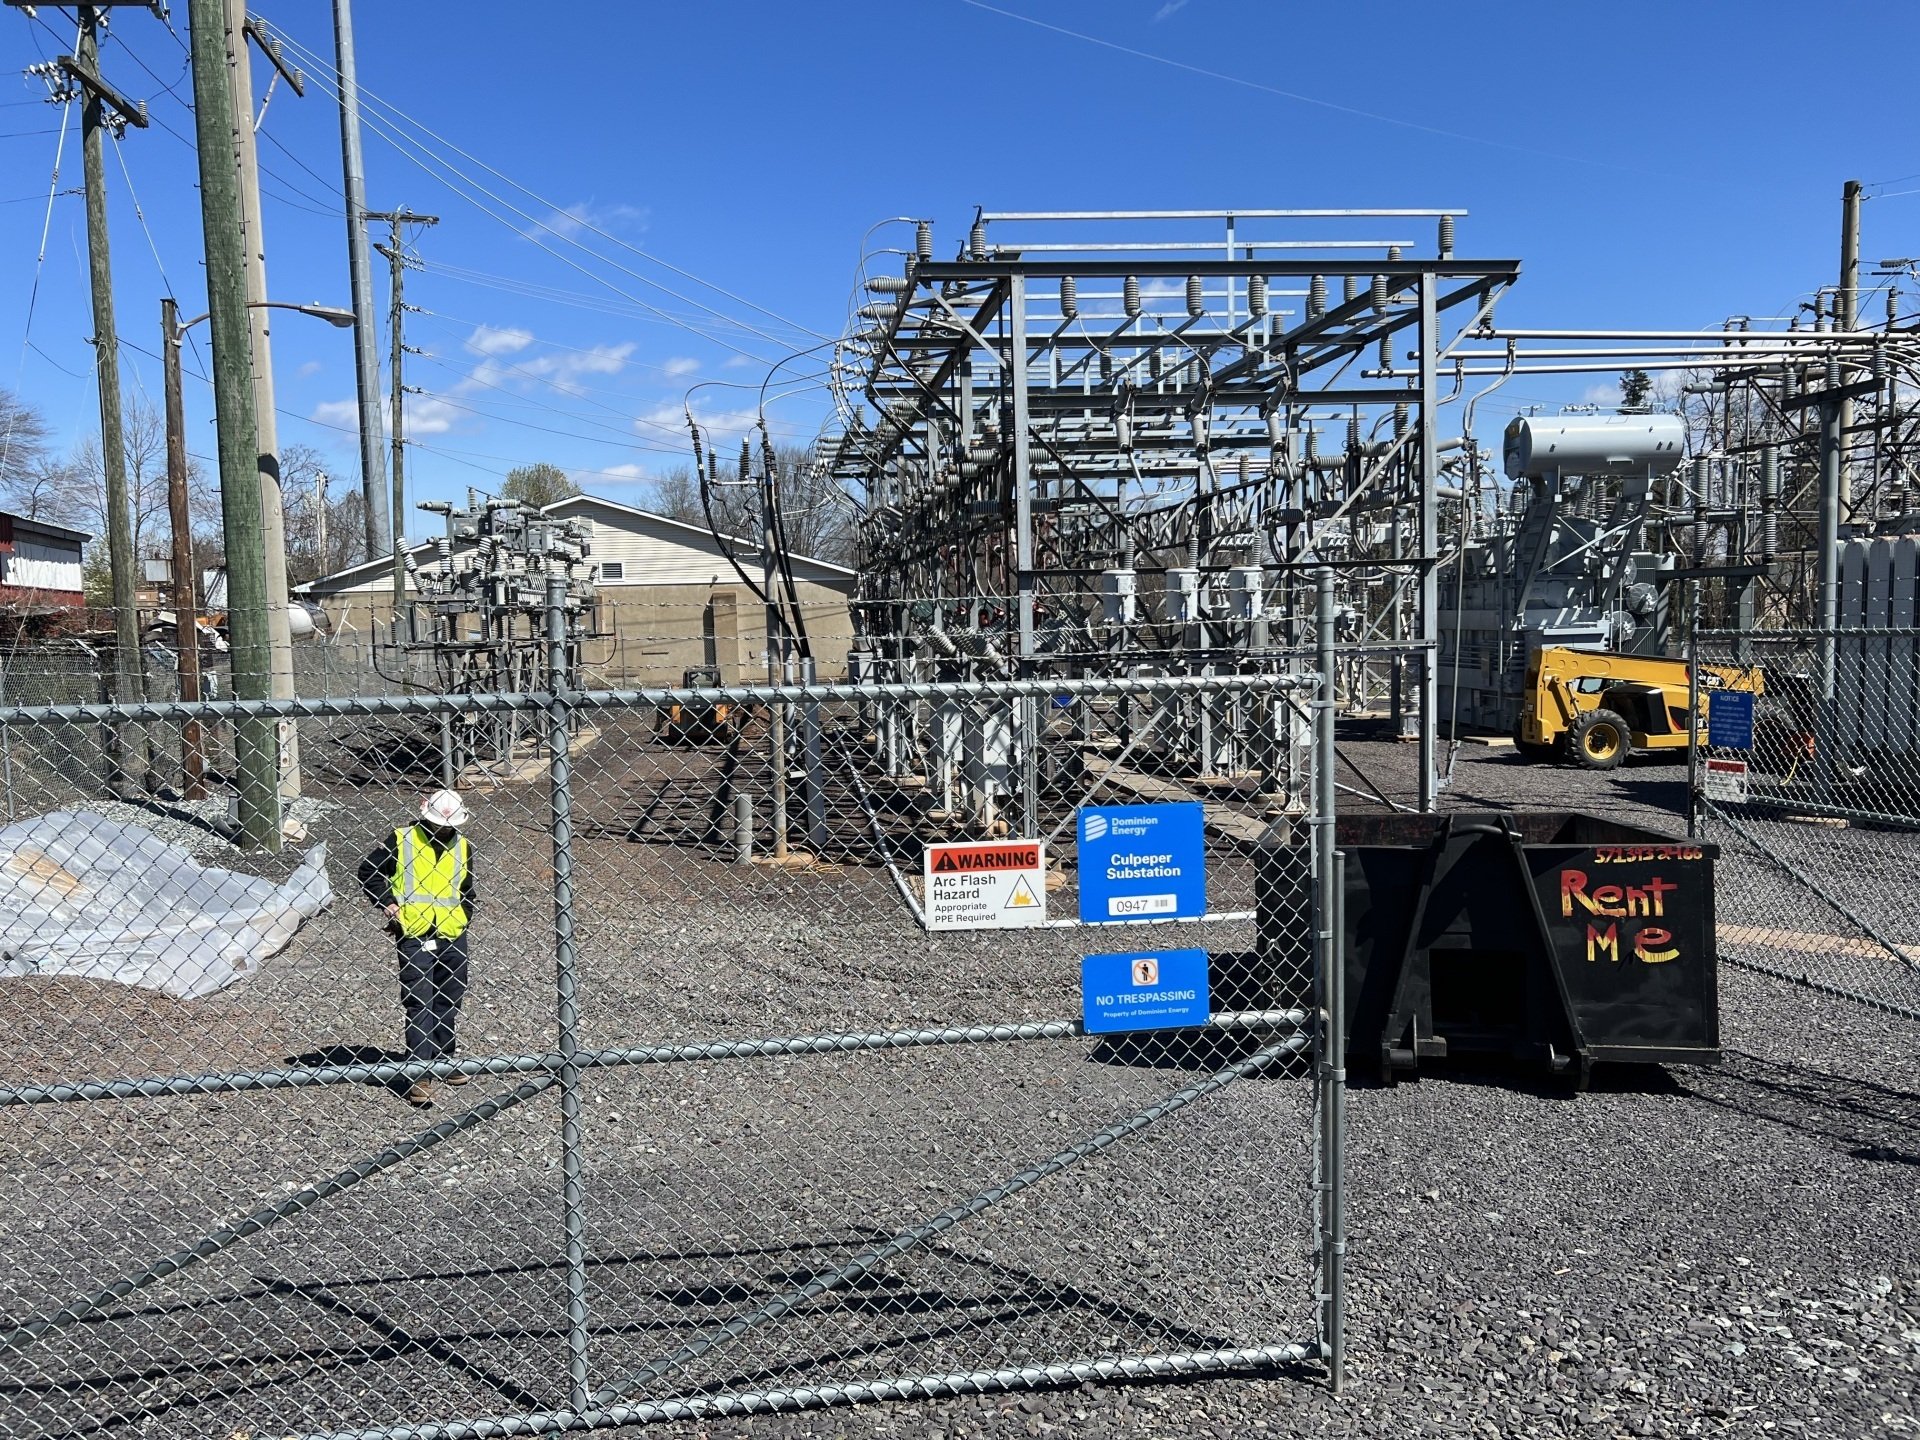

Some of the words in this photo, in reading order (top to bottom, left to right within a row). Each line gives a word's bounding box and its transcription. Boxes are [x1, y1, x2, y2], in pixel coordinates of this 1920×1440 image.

[1111, 816, 1159, 827] Dominion
[1111, 826, 1147, 837] Energy
[957, 851, 1037, 869] WARNING
[1110, 853, 1173, 867] Culpeper
[1106, 866, 1182, 880] Substation
[933, 876, 957, 888] Arc
[960, 874, 996, 886] Flash
[933, 888, 980, 900] Hazard
[1560, 869, 1678, 918] Rent
[934, 903, 987, 913] Appropriate
[1116, 899, 1148, 913] 0947
[934, 914, 954, 923] PPE
[956, 913, 996, 923] Required
[1586, 922, 1680, 964] Me
[1096, 995, 1114, 1006] NO
[1116, 990, 1196, 1005] TRESPASSING
[1137, 1008, 1167, 1016] Dominion
